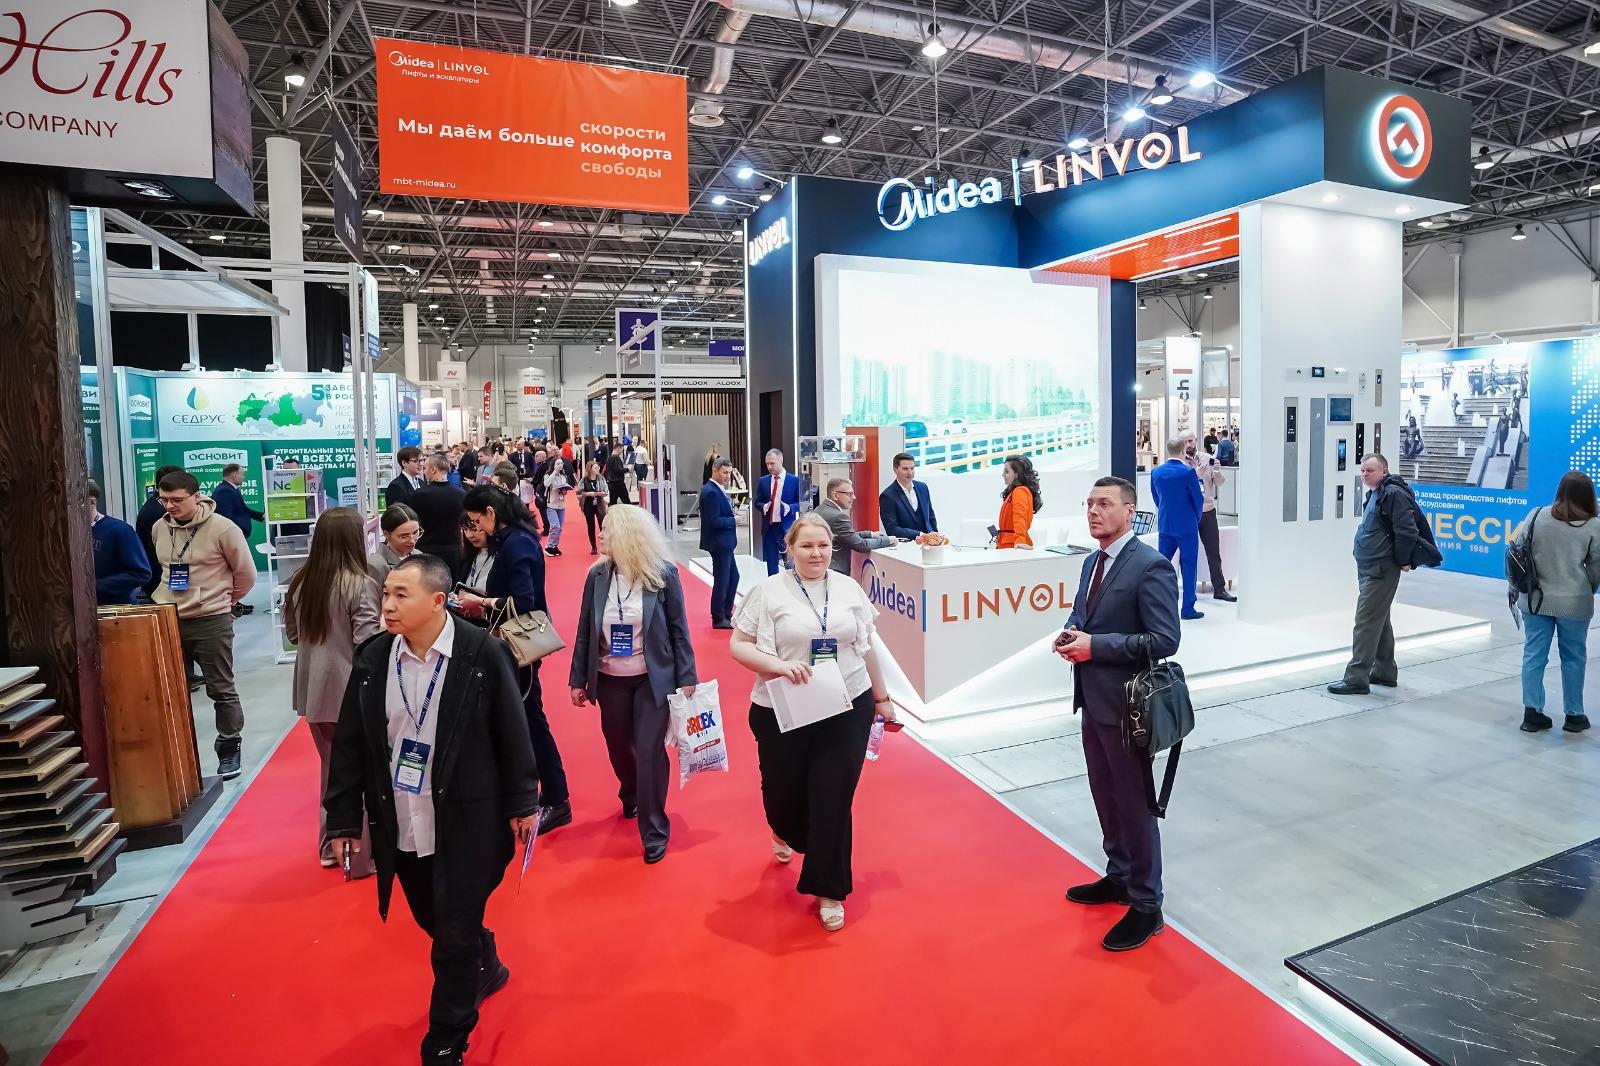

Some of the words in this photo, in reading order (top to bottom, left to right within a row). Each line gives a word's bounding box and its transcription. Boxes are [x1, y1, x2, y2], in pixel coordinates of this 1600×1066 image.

[388, 50, 435, 69] Midea
[444, 61, 490, 76] LINVOL
[401, 69, 428, 78] Лифты
[435, 74, 480, 84] эскалаторы
[0, 111, 118, 138] OMPANY
[580, 121, 666, 141] скорости
[398, 117, 433, 135] Мы
[439, 122, 492, 143] даём
[498, 127, 575, 148] больше
[580, 140, 672, 163] комфорта
[580, 160, 662, 180] свободы
[877, 176, 1002, 231] Midea
[1033, 126, 1203, 193] LINVOL
[393, 177, 456, 189] mbt-midea.ru
[311, 384, 325, 400] 5
[172, 414, 226, 424] СЕДРУС
[189, 452, 244, 461] ОСНОВИТ
[302, 454, 332, 463] ВСЕХ
[1420, 491, 1441, 500] завод
[1442, 493, 1494, 503] производства
[1496, 496, 1528, 506] лифтов
[861, 558, 916, 621] Midea
[942, 582, 1073, 623] LINVOL
